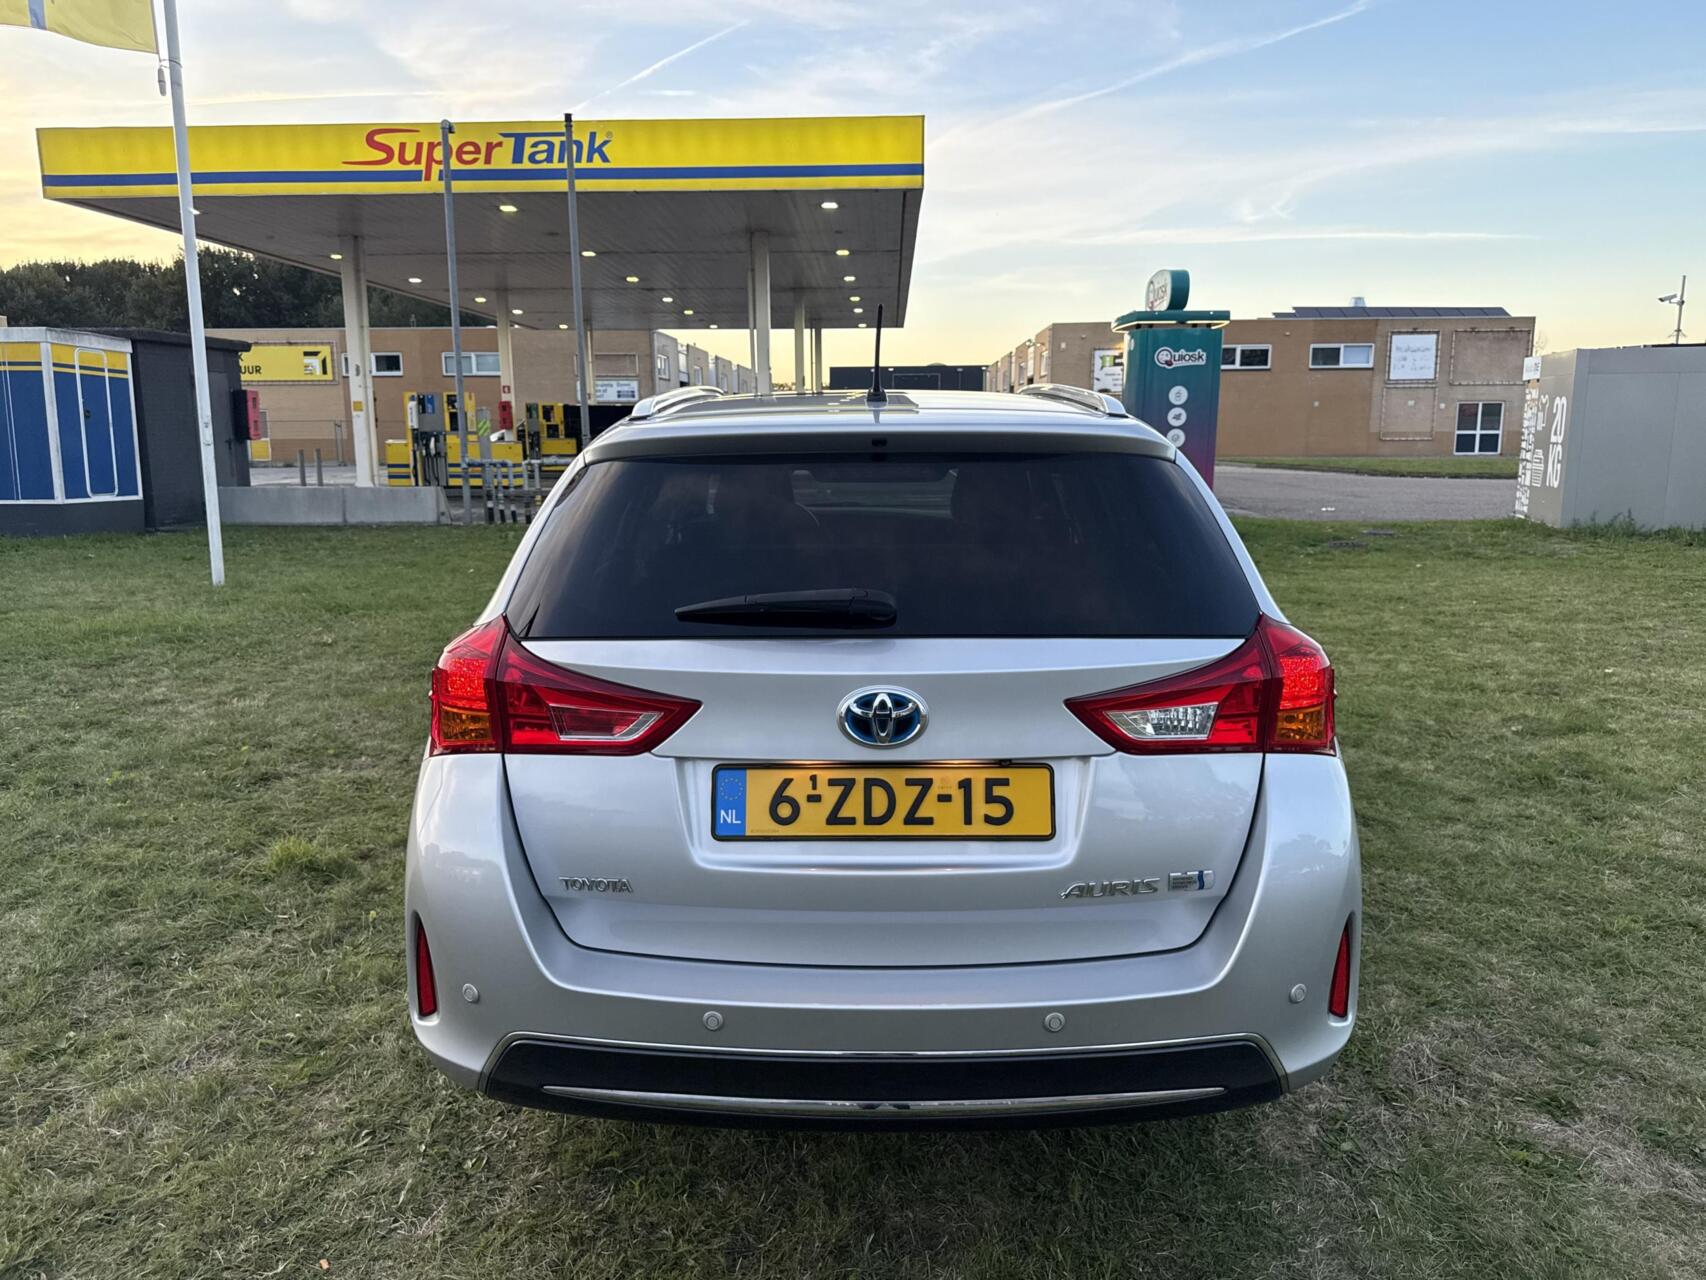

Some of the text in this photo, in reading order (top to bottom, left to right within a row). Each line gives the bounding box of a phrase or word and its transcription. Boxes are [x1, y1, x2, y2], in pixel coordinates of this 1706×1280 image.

[1156, 348, 1205, 367] Quiosk
[720, 809, 741, 824] NL
[768, 777, 1014, 826] 6-ZDZ-15
[559, 876, 633, 893] TOYOTA
[1061, 878, 1160, 899] AURIS
